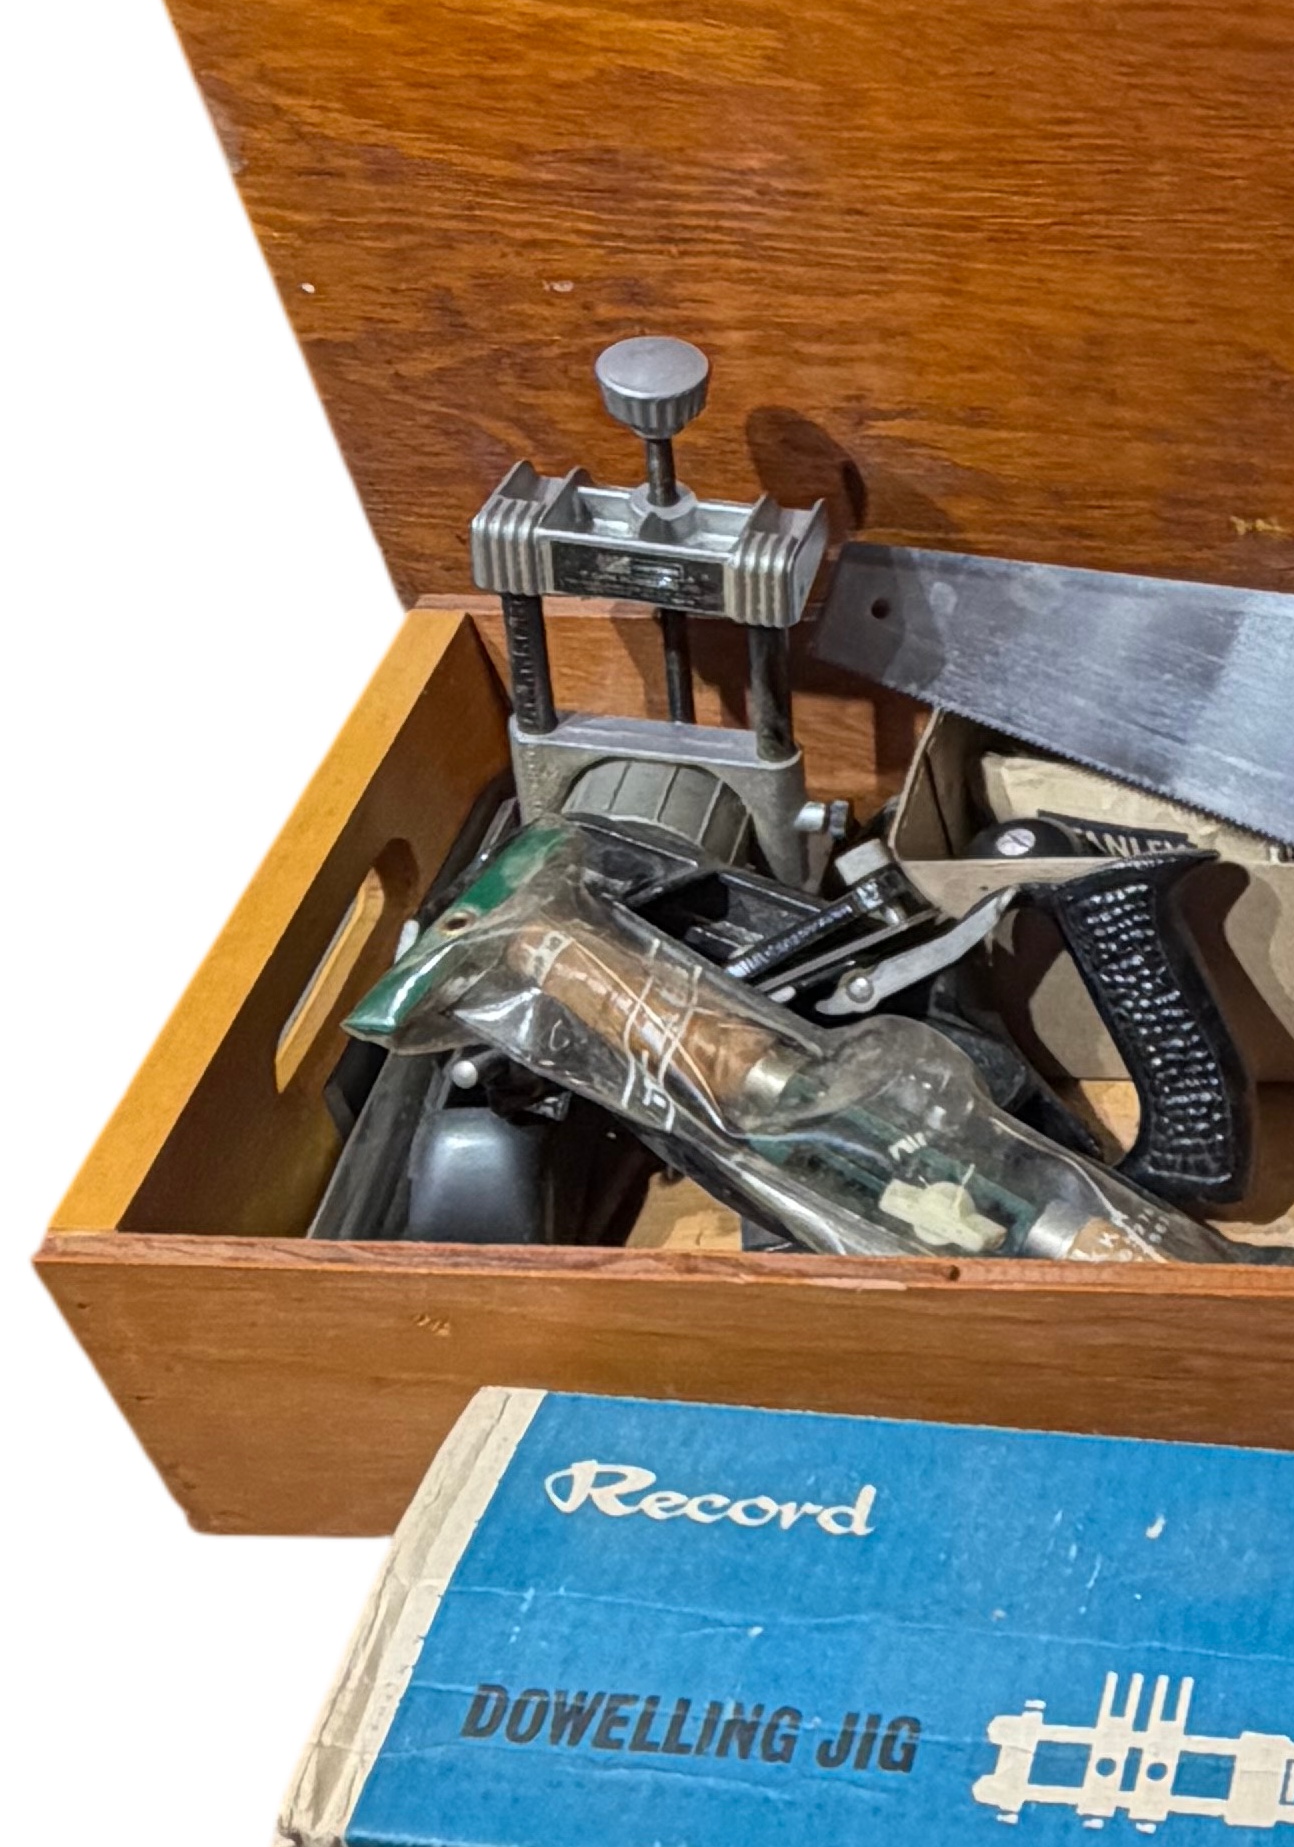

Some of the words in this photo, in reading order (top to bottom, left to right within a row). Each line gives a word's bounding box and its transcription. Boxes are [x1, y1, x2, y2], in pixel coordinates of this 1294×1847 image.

[544, 1458, 877, 1538] Record
[460, 1682, 802, 1764] DOWELLING
[815, 1712, 922, 1775] JIG
